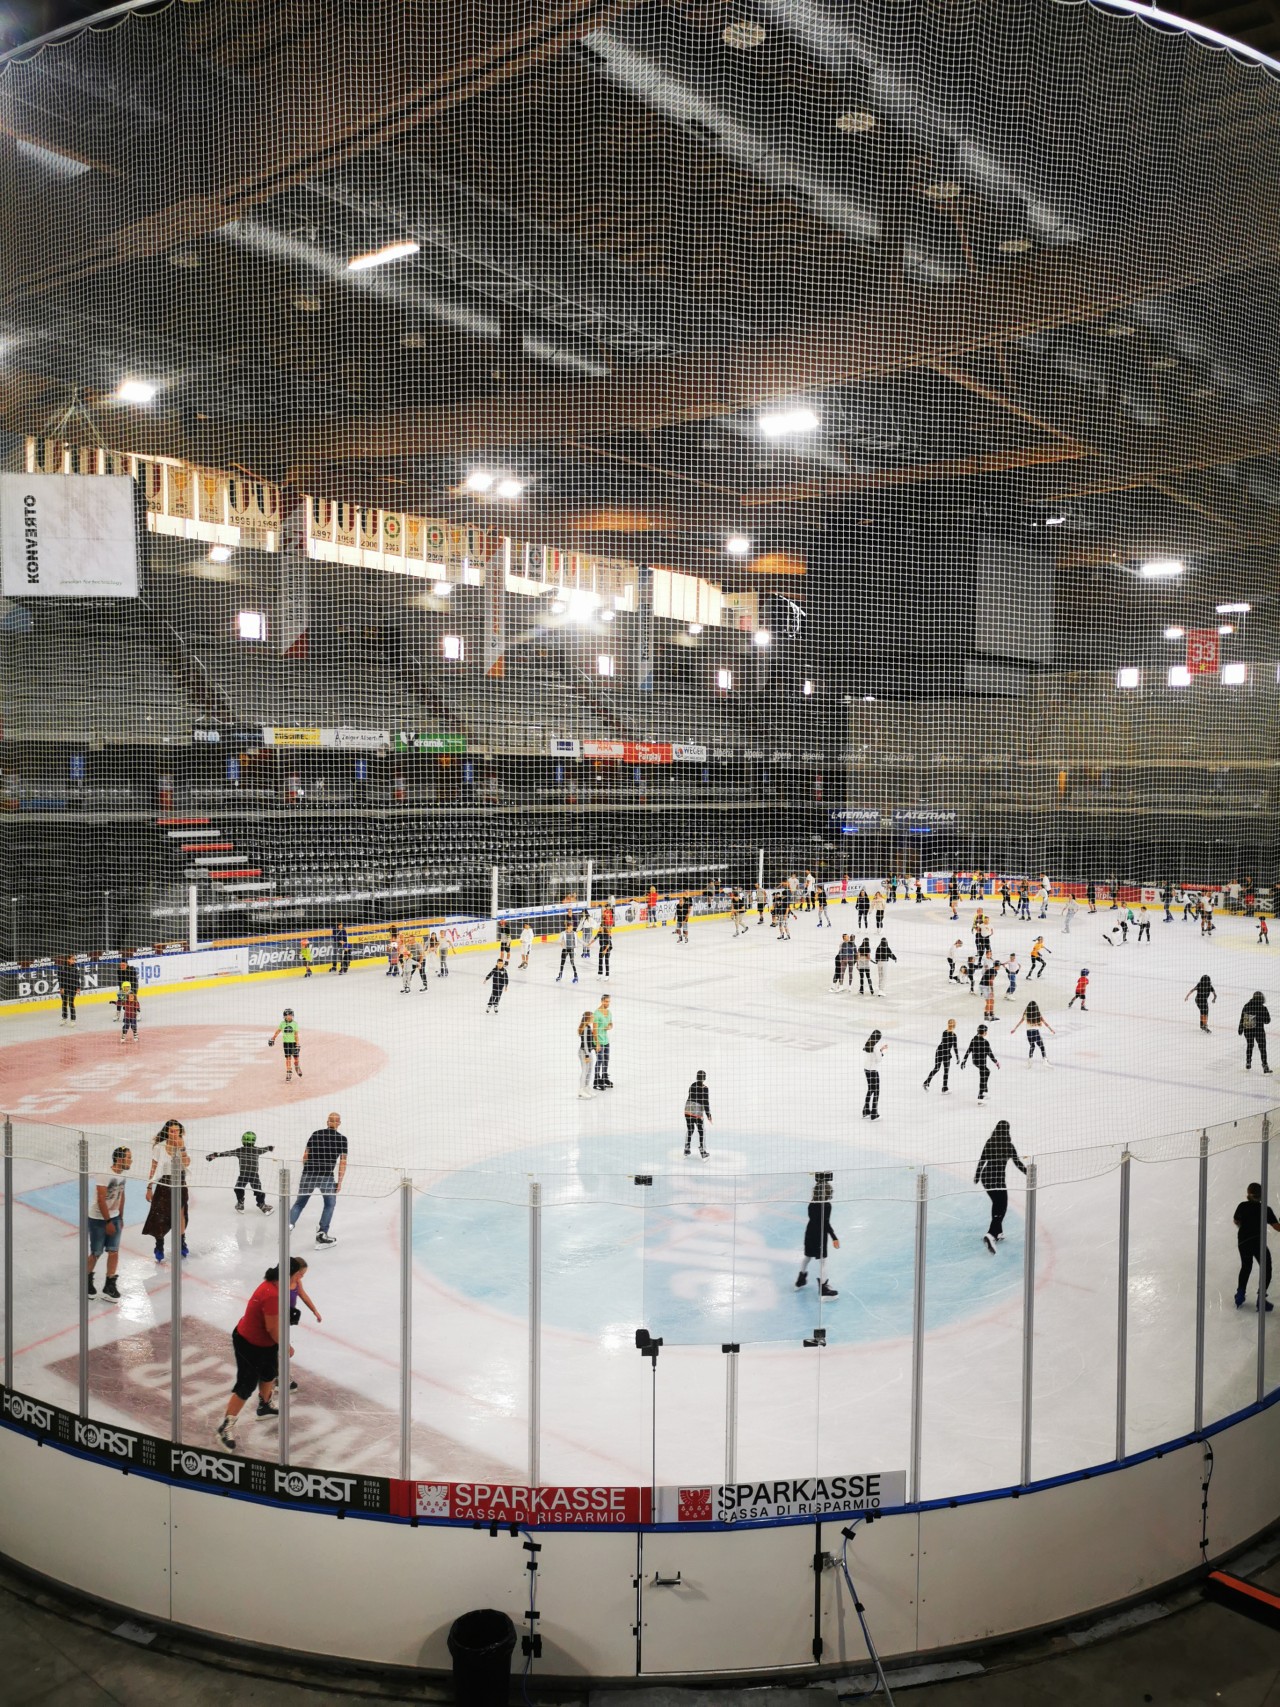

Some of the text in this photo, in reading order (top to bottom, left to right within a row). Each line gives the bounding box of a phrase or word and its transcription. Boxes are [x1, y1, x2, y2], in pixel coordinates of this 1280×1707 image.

[23, 494, 40, 584] KONVERTO
[312, 530, 331, 539] 1997
[831, 811, 880, 820] LATEMAR
[895, 811, 956, 821] LATEMAR
[248, 946, 296, 969] alperia
[18, 964, 98, 980] KELLEI
[18, 973, 98, 997] BOZN
[3, 1391, 55, 1431] FORST
[74, 1420, 138, 1458] FORST
[171, 1449, 245, 1485] FORST
[250, 1464, 266, 1472] BIRRA
[250, 1471, 266, 1479] BIERE
[274, 1469, 357, 1502] FORST
[717, 1474, 881, 1510] SPARKASSE
[455, 1483, 626, 1513] SPARKASSE
[717, 1497, 881, 1523] CASSA DI RISPARMIO
[455, 1508, 507, 1521] CASSA
[538, 1511, 626, 1523] RISPARMIO
